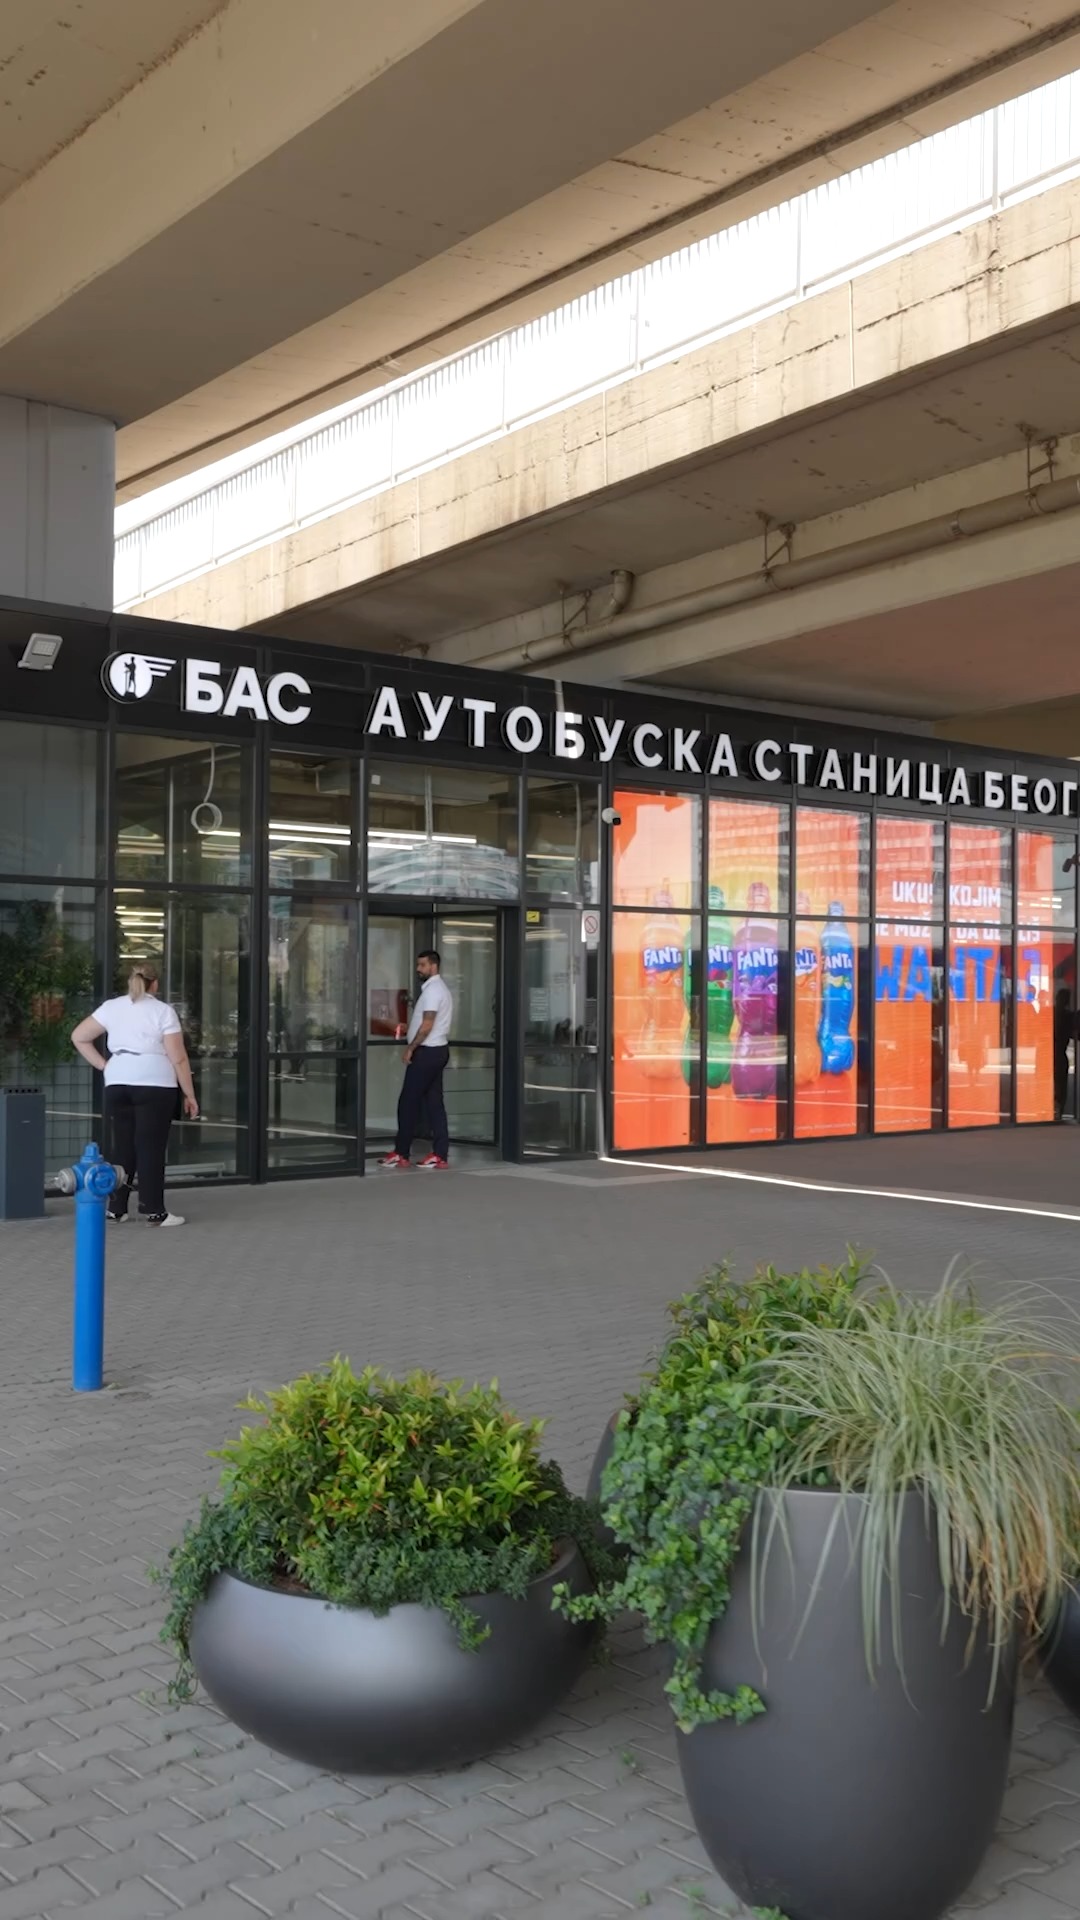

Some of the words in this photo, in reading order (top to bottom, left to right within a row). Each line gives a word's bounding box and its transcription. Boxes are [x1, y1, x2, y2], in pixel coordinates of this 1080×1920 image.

[185, 658, 312, 725] БАС
[367, 686, 739, 778] АУТОБУСКА
[755, 739, 971, 806] СТАНИЦА
[984, 770, 1078, 816] БЕОГ
